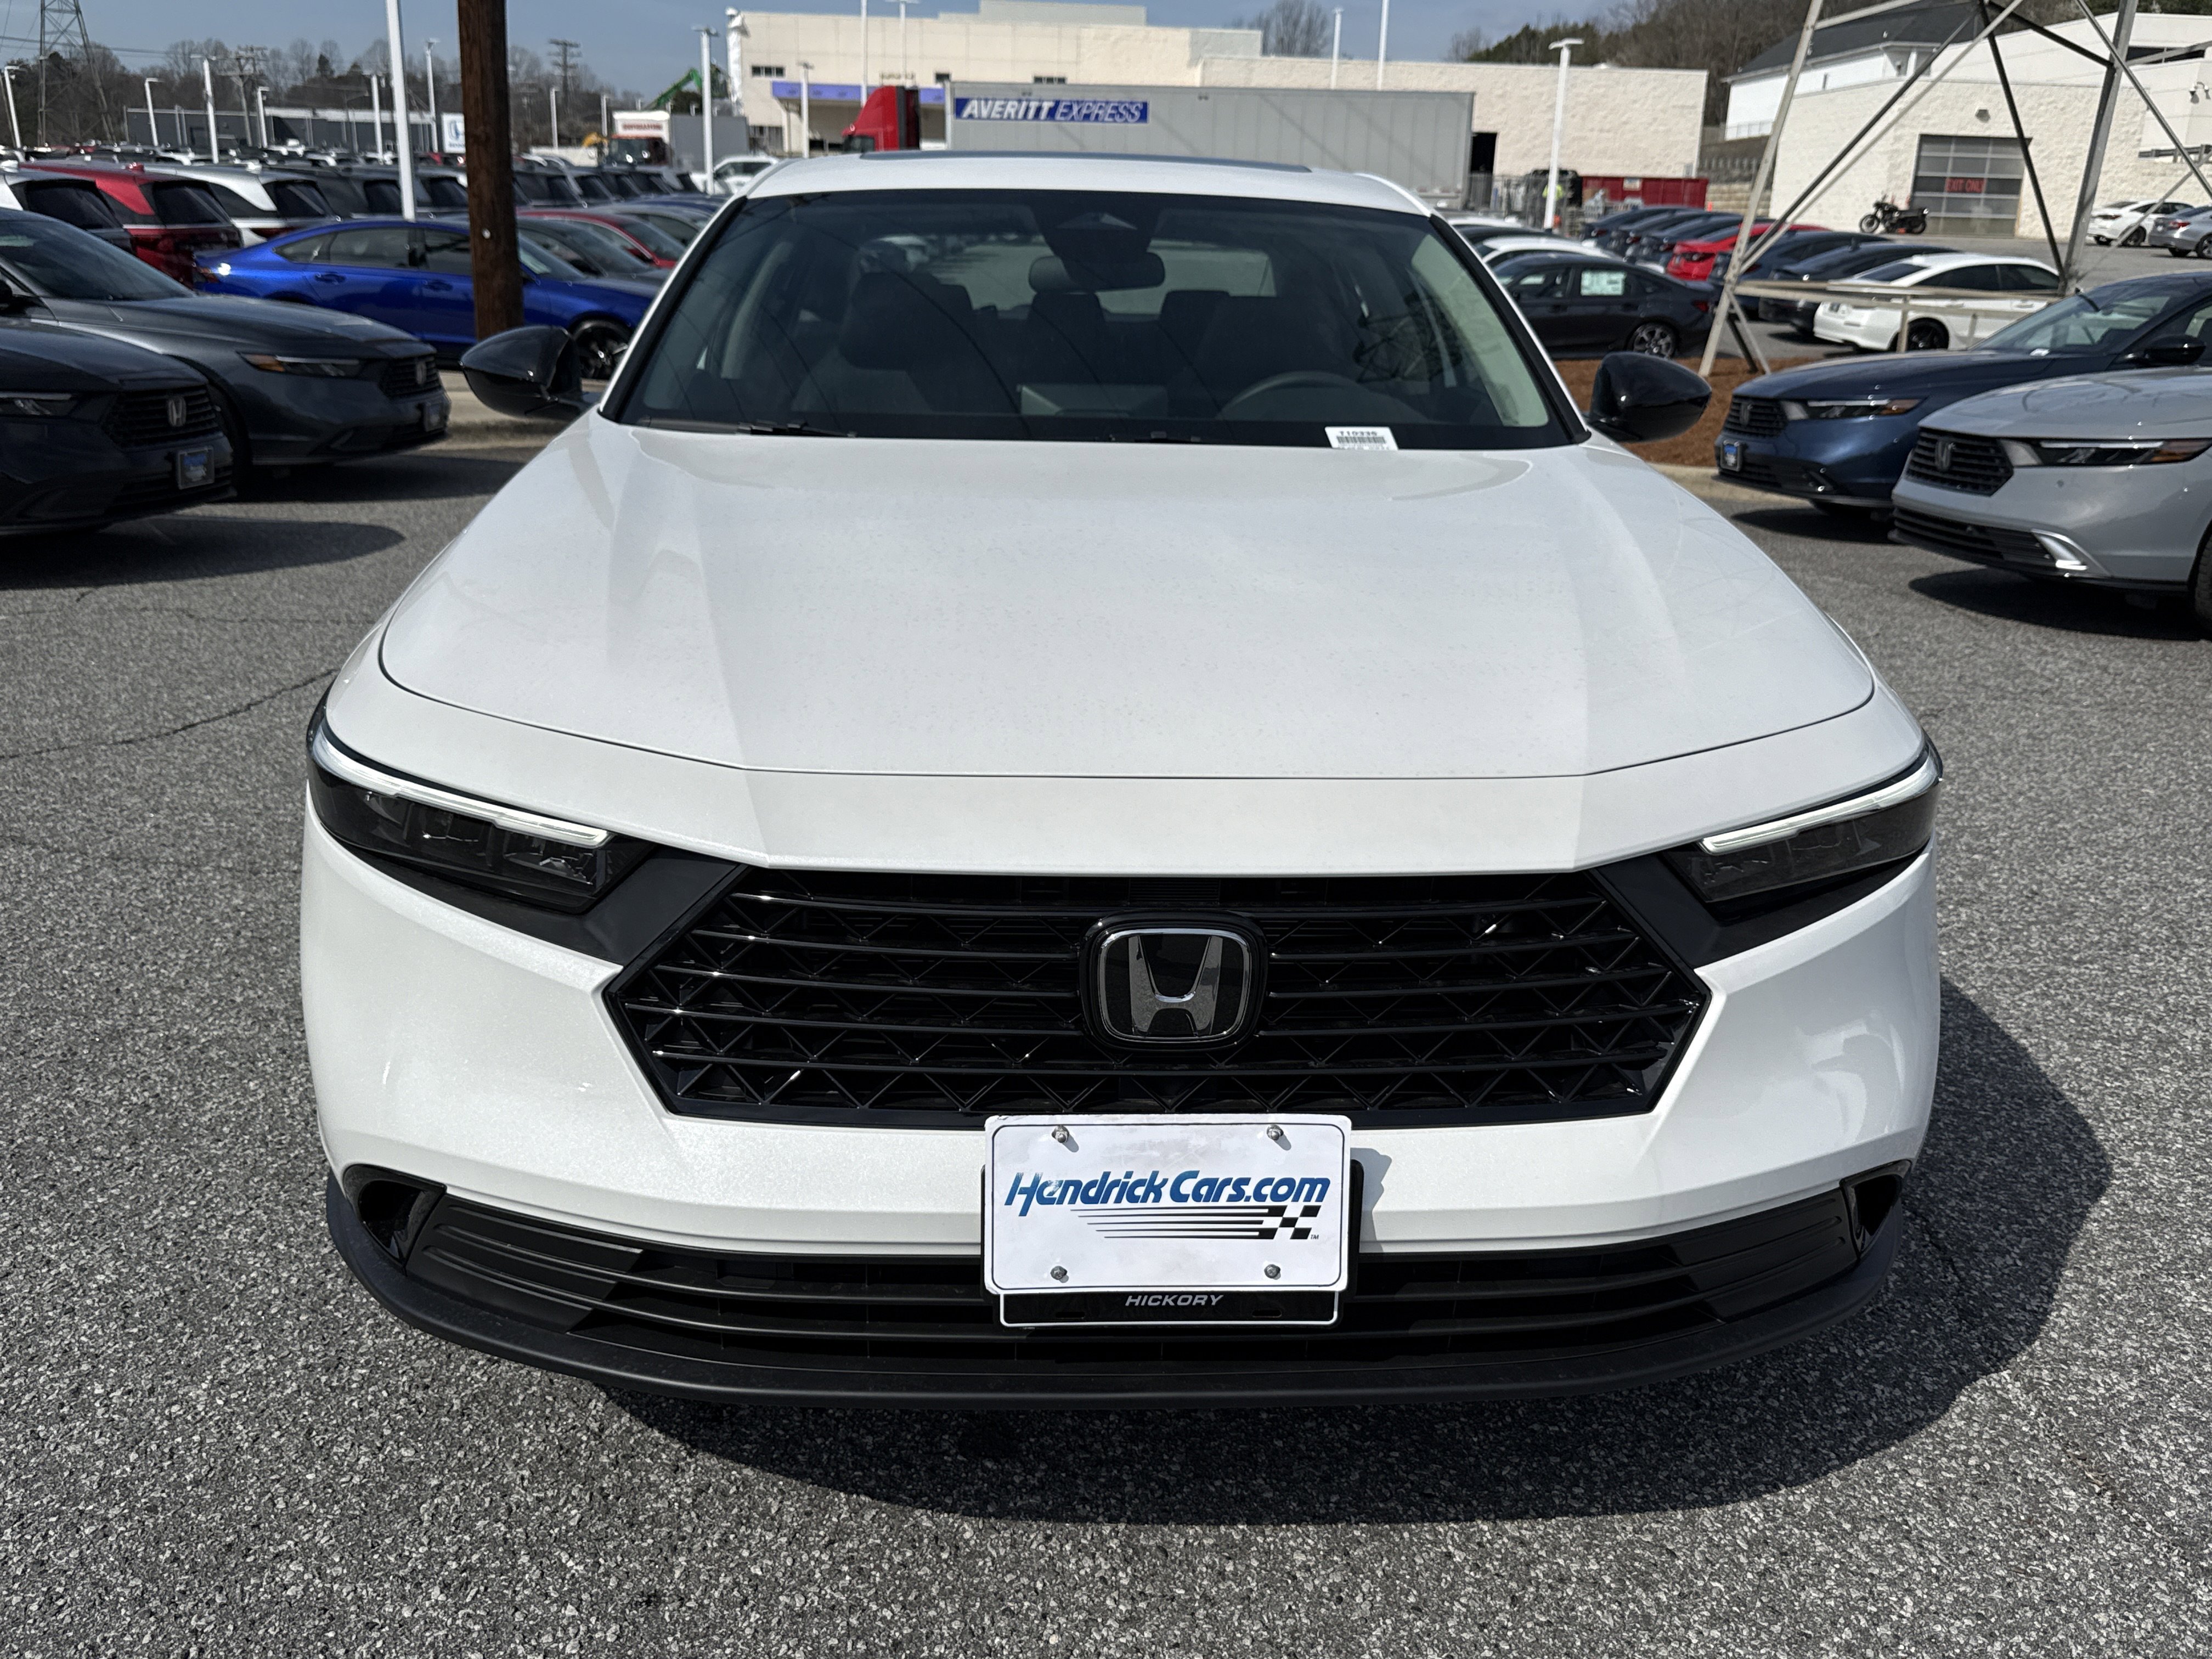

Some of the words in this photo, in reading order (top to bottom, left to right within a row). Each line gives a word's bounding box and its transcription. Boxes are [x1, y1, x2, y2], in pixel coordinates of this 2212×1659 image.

[962, 99, 1054, 120] AVERITT
[1055, 100, 1143, 122] EXPRESS
[1125, 1294, 1224, 1307] HICKORY
